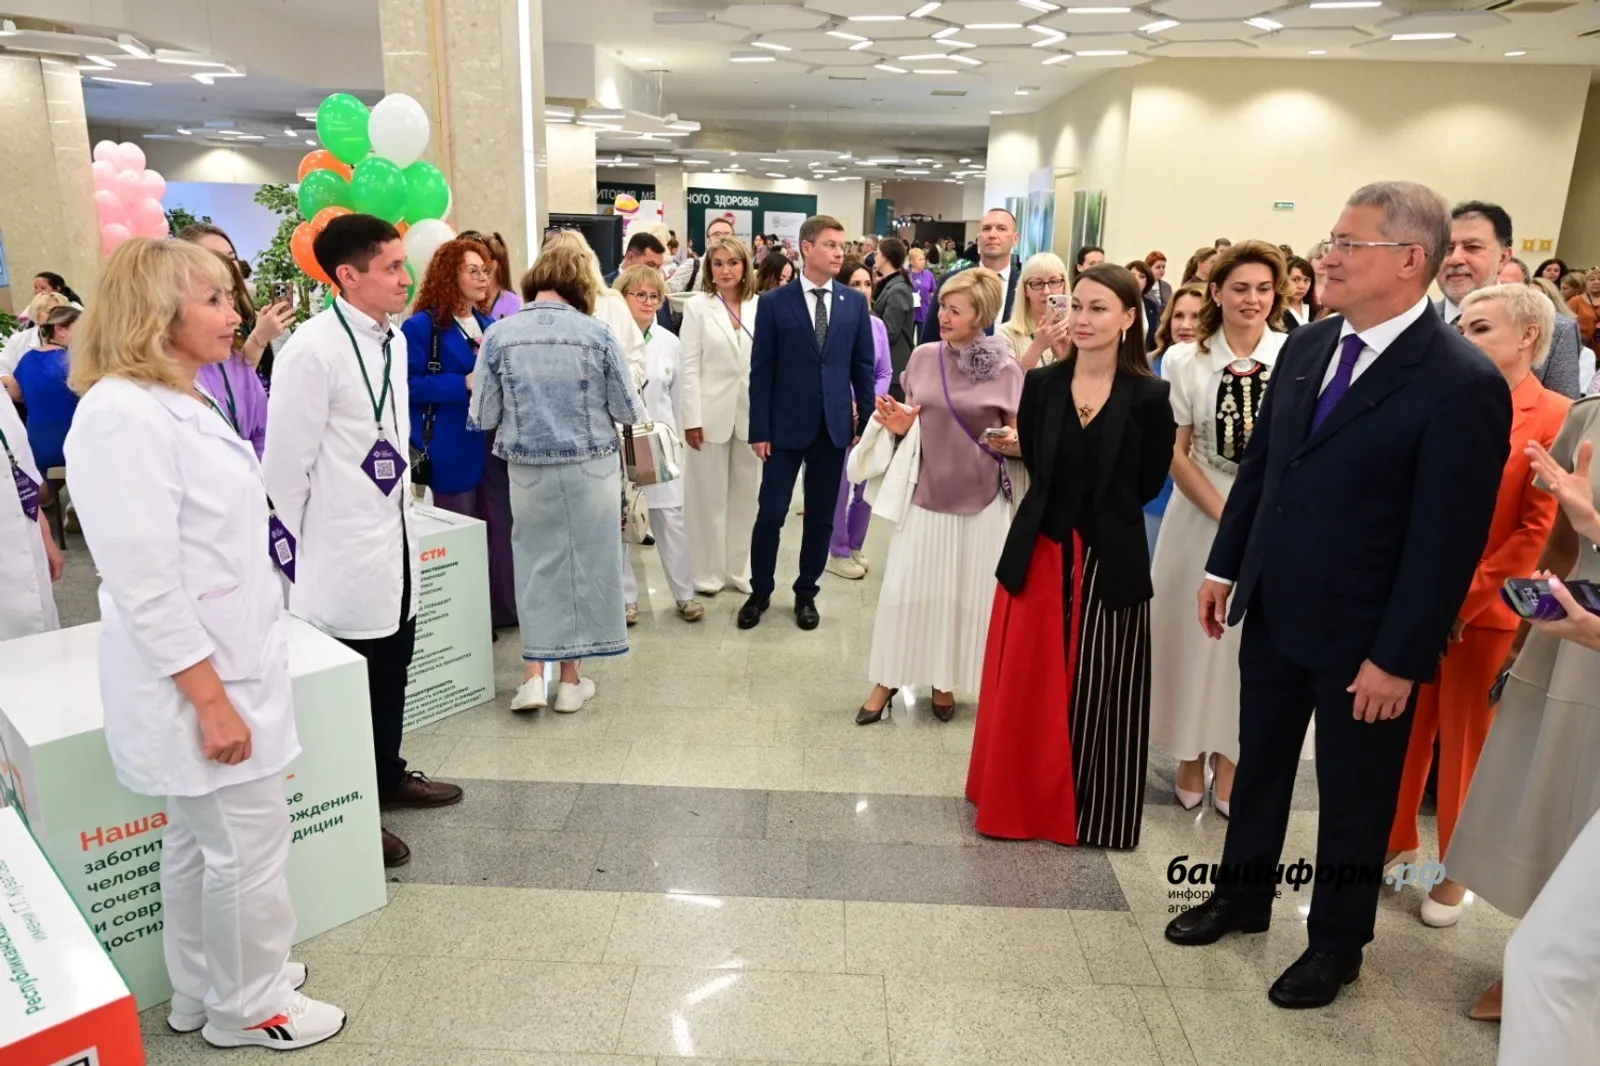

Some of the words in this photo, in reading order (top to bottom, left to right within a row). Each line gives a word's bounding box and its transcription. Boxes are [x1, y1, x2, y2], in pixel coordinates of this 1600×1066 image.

[714, 194, 759, 208] ЗДОРОВЬЯ
[80, 811, 169, 852] Наша
[87, 861, 161, 893] челове
[90, 881, 161, 914] сочета
[292, 814, 344, 844] диции
[94, 922, 107, 935] и
